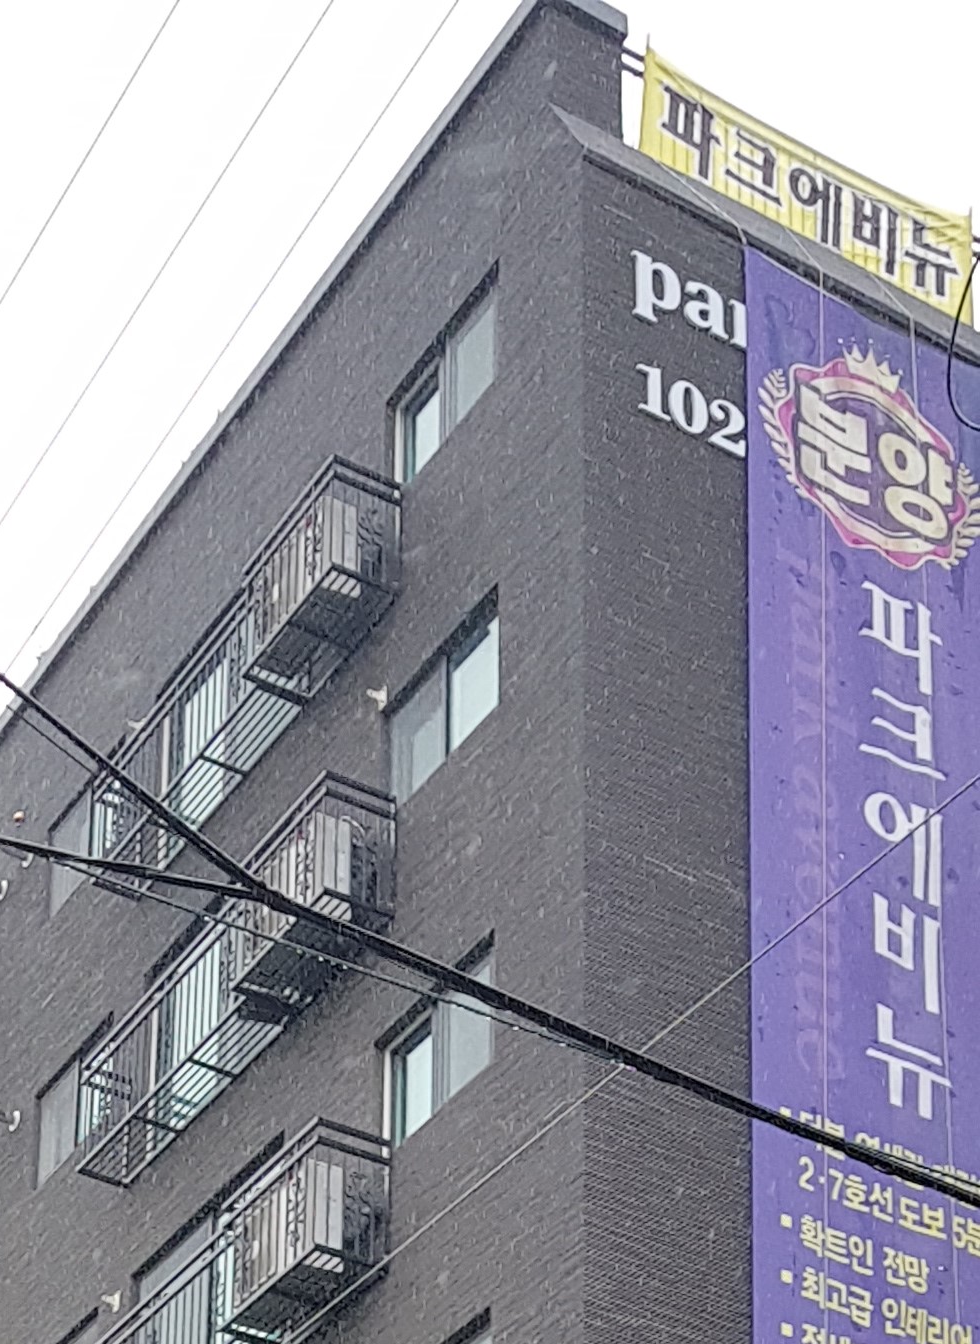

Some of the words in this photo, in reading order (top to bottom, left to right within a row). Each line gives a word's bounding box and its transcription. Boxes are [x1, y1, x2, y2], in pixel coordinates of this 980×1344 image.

[661, 84, 958, 297] 파크에비뉴
[636, 362, 746, 459] 102
[799, 384, 956, 540] 분양
[858, 580, 952, 1120] 파크에비뉴
[799, 1213, 874, 1276] 확트인
[883, 1247, 930, 1294] 전망
[899, 1199, 948, 1239] 도보
[800, 1268, 873, 1327] 최고급
